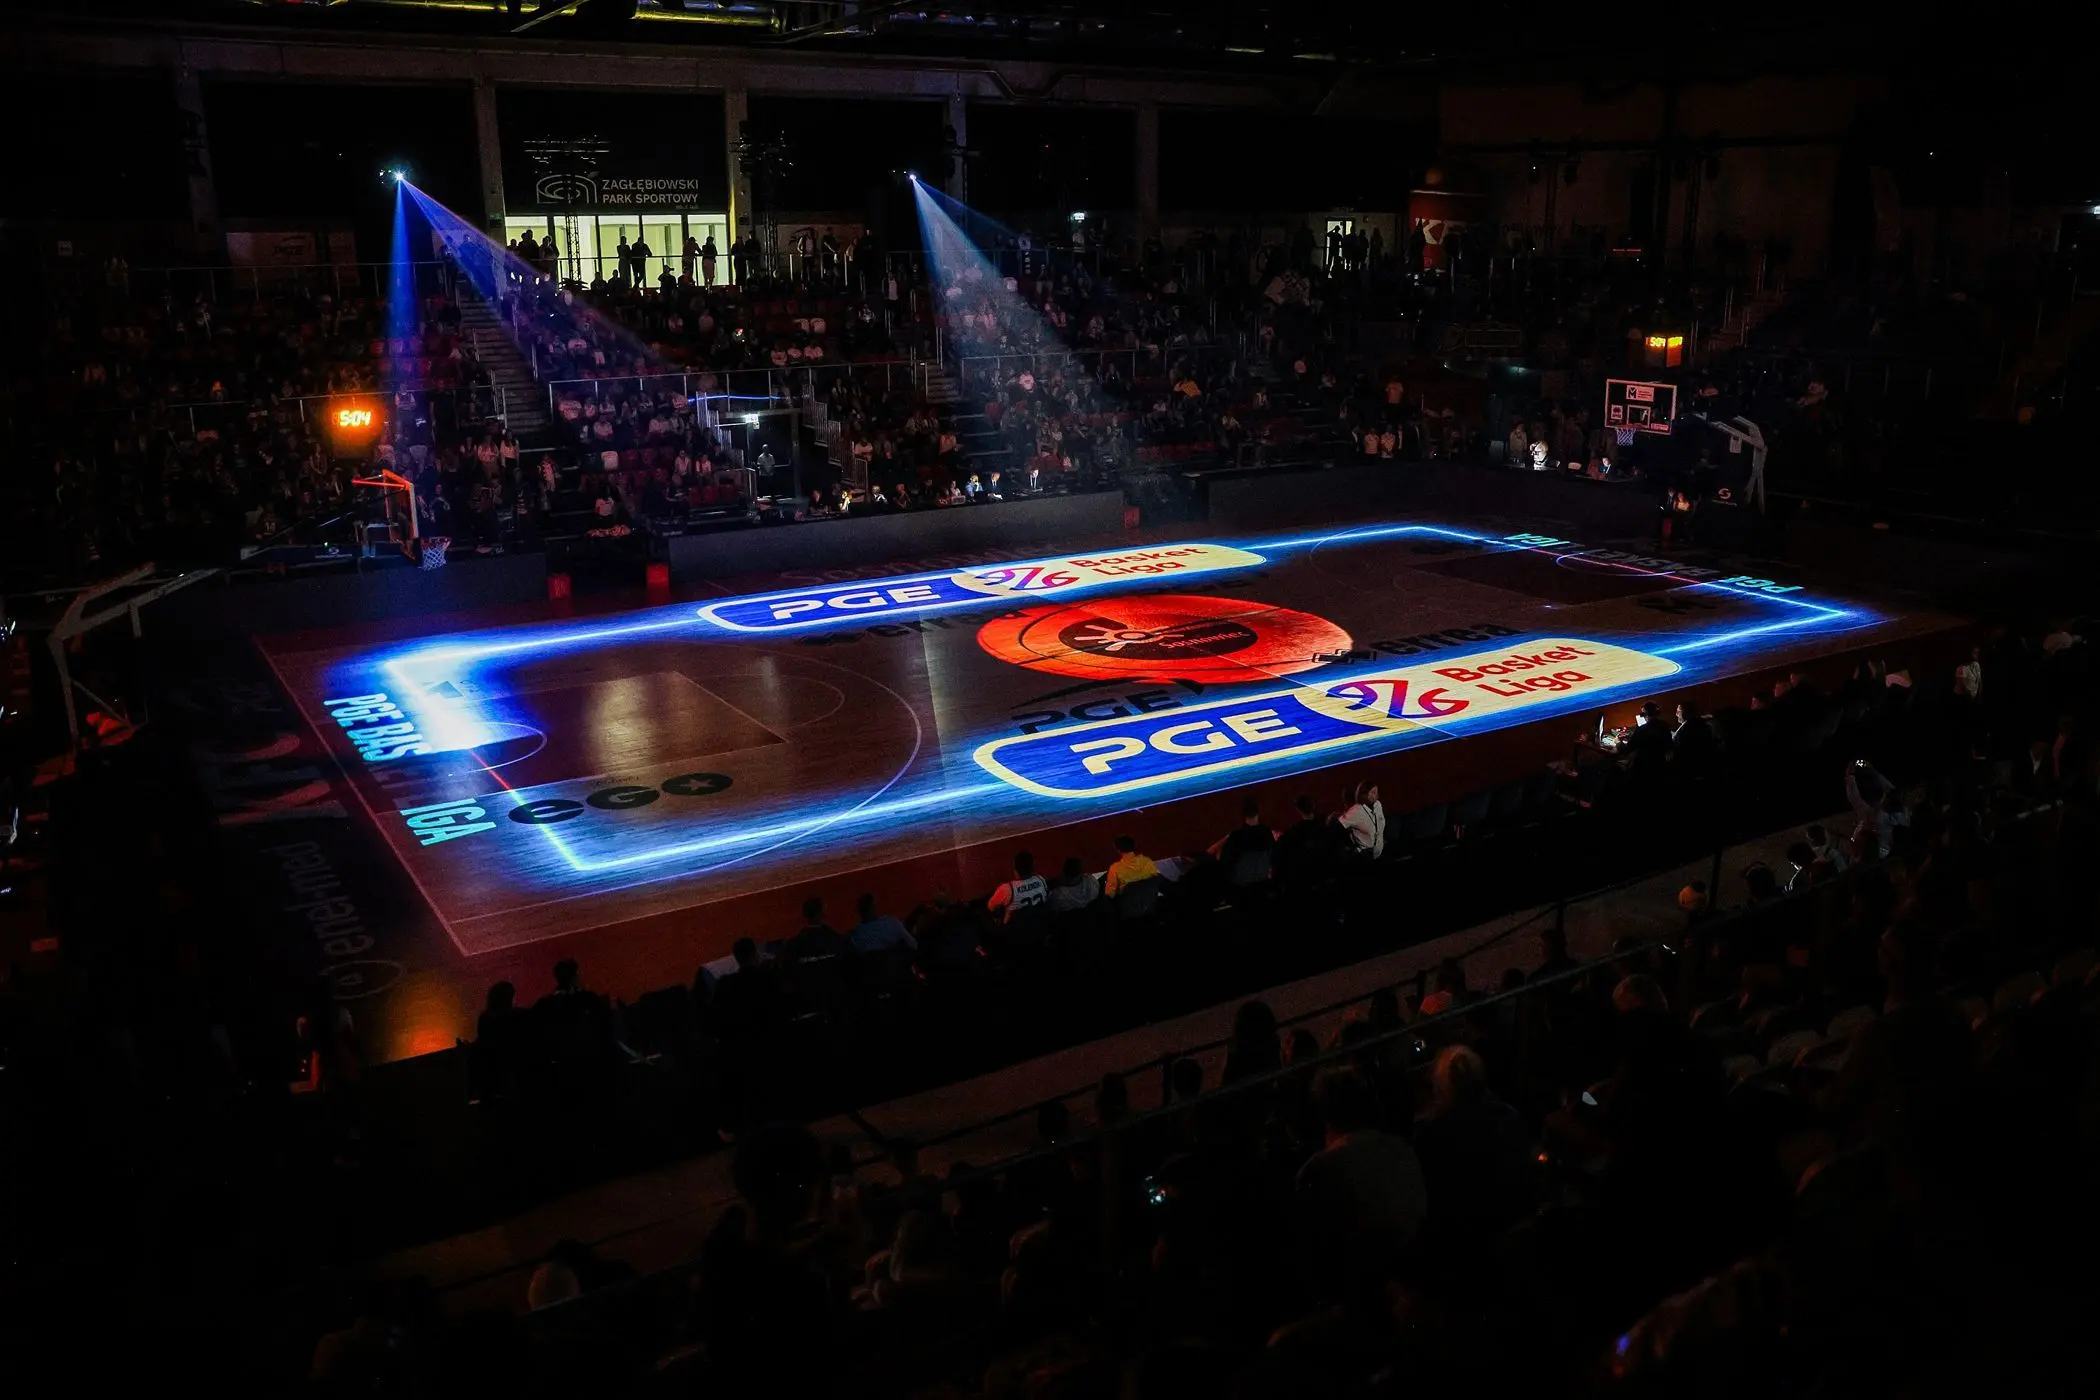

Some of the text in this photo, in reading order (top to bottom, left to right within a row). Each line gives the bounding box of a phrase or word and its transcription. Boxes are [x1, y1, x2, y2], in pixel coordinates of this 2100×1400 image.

[602, 179, 699, 192] ZAGŁĘBIOWSKI
[602, 193, 699, 203] PARK SPORTOWY
[769, 547, 1208, 620] PGE Basket
[1090, 560, 1187, 577] Liga
[1371, 624, 1526, 655] errea
[1476, 665, 1593, 700] Liga
[323, 693, 405, 730] PGE
[1012, 690, 1183, 735] PGE
[1070, 645, 1597, 776] PGE Basket
